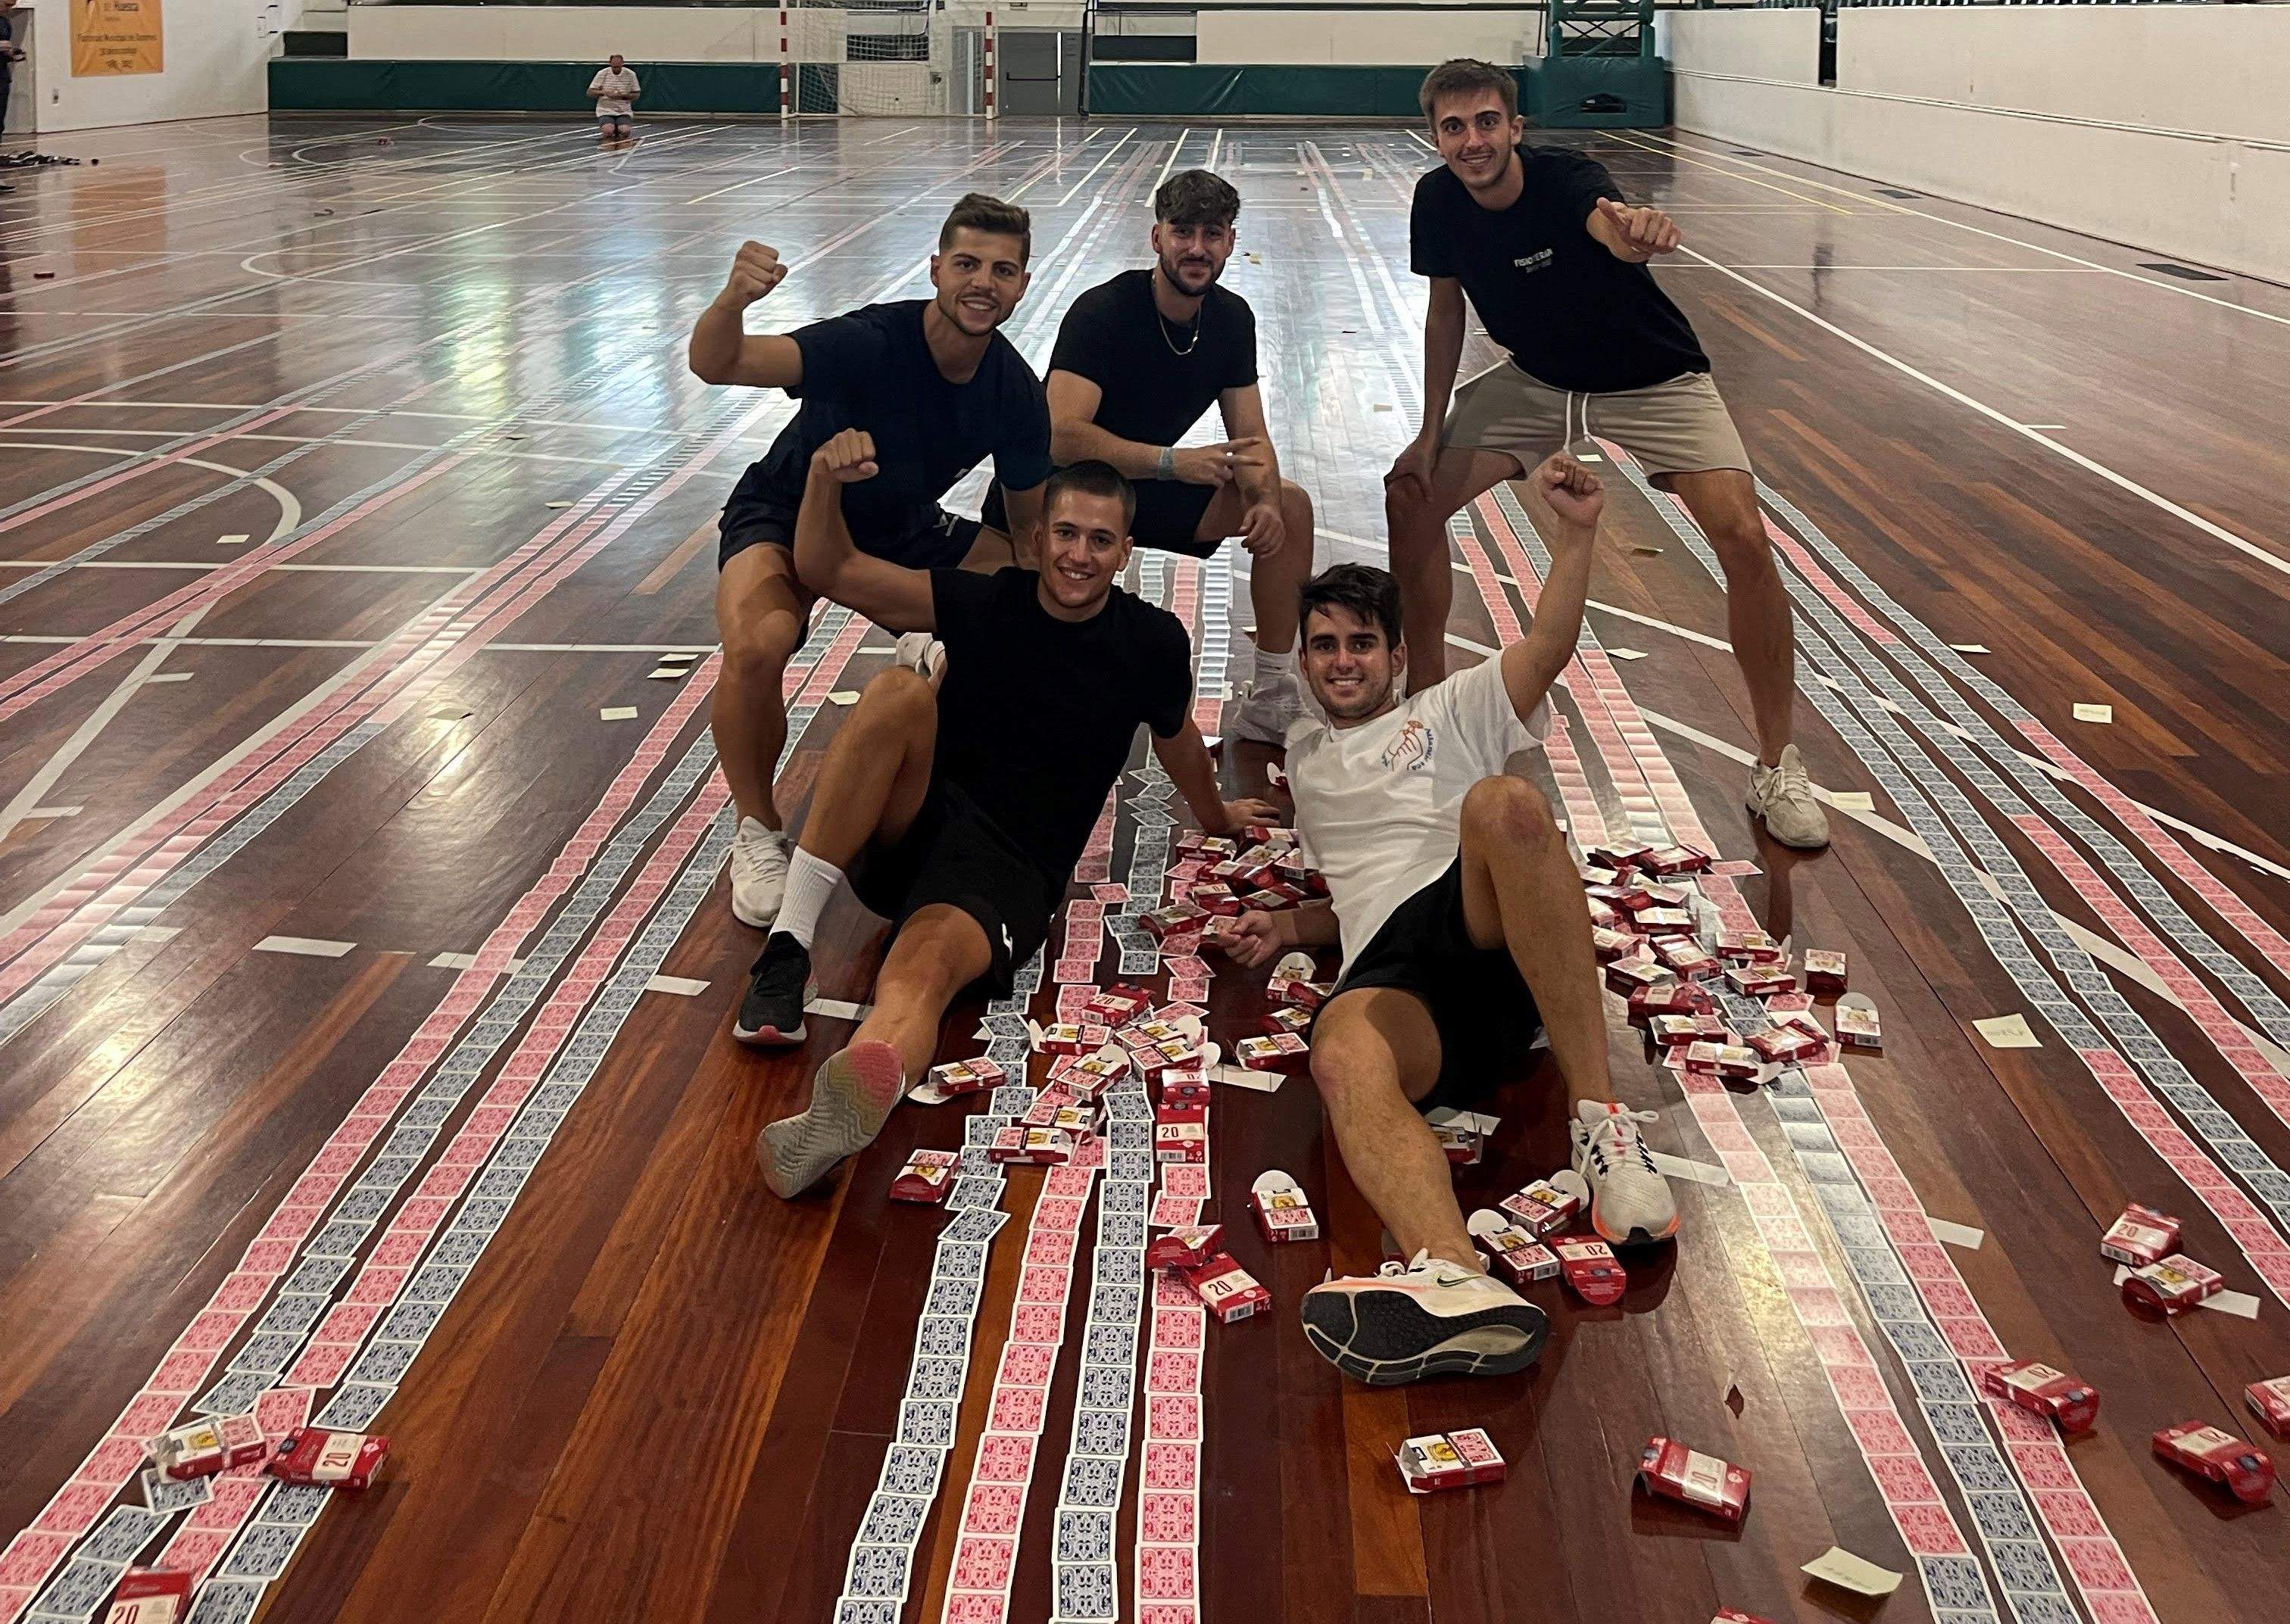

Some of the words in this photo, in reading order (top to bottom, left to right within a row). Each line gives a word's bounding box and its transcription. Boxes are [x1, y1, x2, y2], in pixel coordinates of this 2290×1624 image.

[1162, 1126, 1179, 1138] 20
[2116, 1223, 2139, 1238] 20
[1585, 1244, 1608, 1255] 20
[1208, 1280, 1233, 1296] 20
[2027, 1366, 2057, 1378] 20
[2198, 1429, 2229, 1443] 20
[323, 1452, 352, 1467] 20
[112, 1604, 139, 1624] 20
